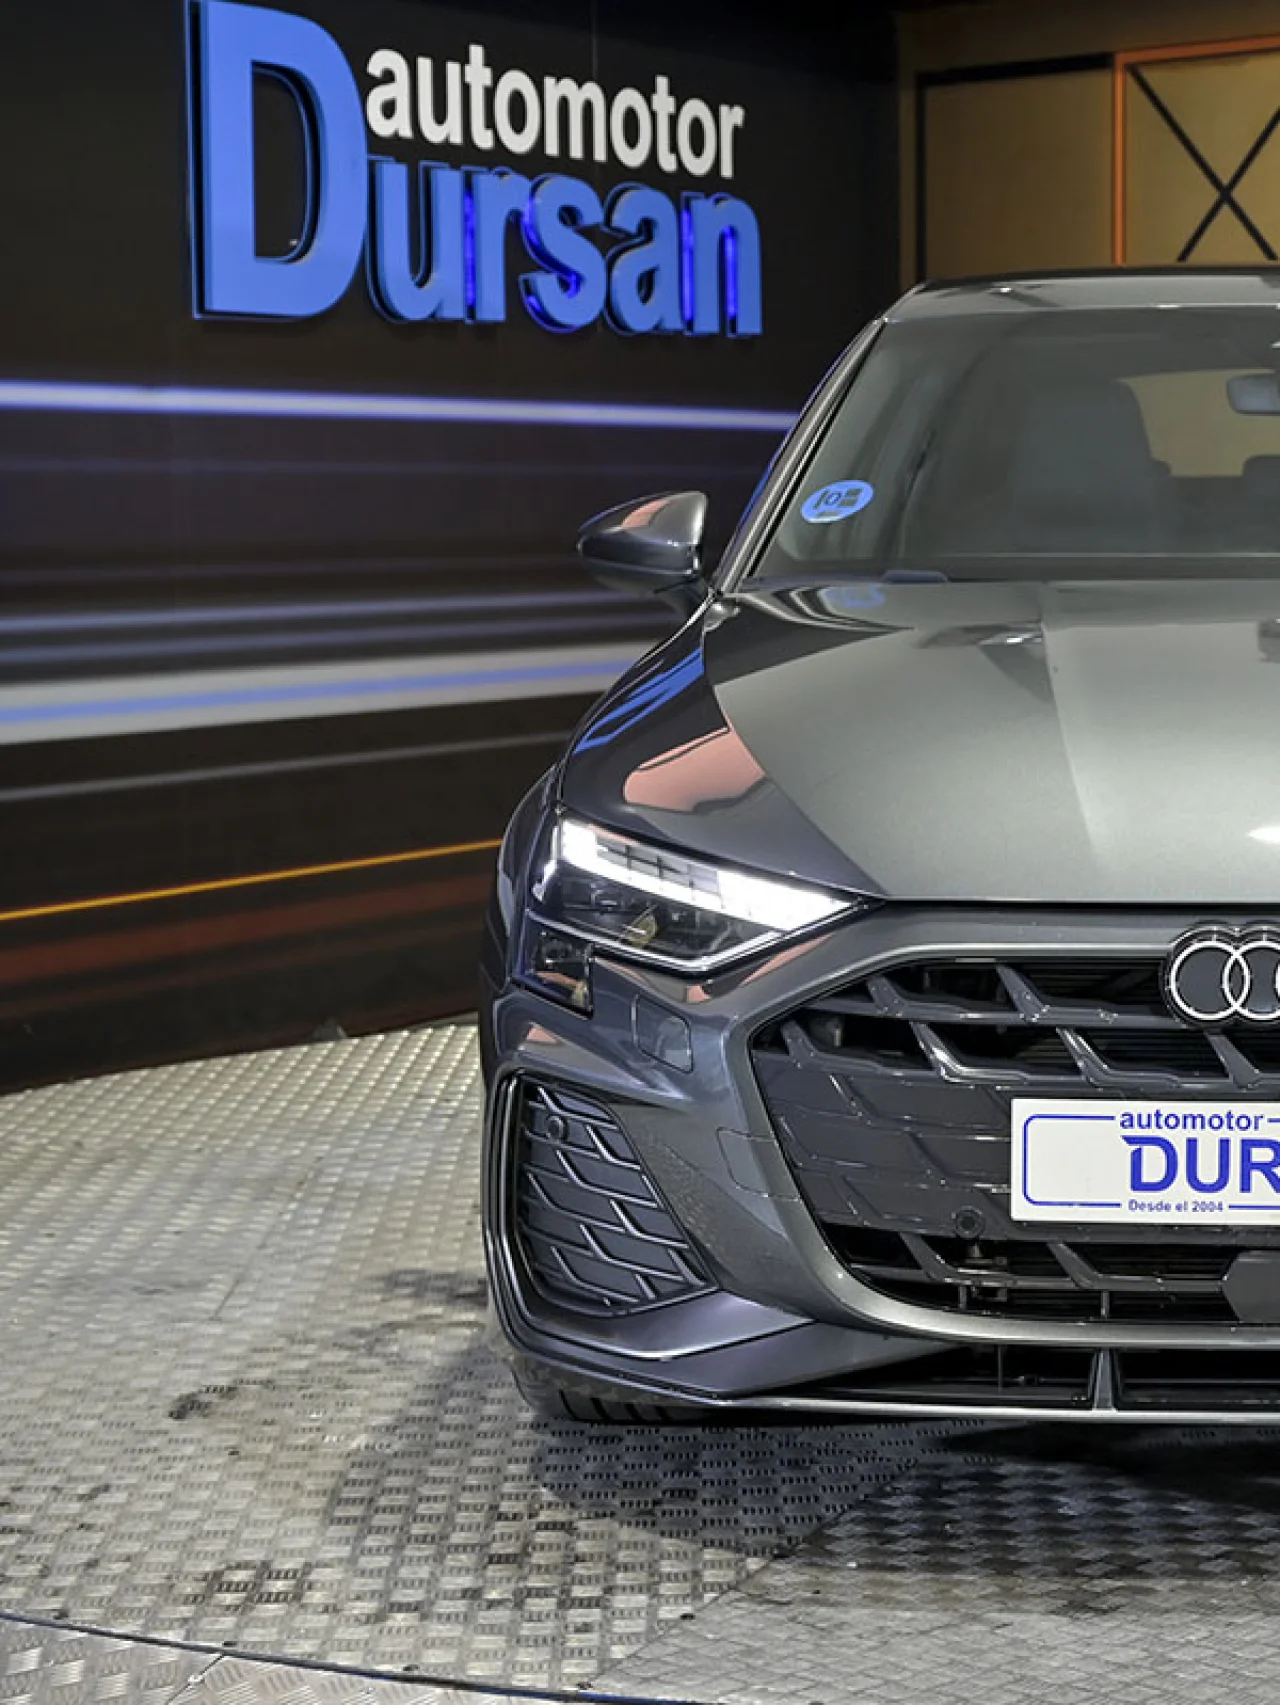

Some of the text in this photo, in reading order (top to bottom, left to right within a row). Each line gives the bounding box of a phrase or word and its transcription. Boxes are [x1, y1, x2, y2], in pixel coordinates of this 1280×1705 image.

[366, 44, 745, 179] automotor
[185, 0, 764, 338] Dursan
[1119, 1109, 1265, 1132] automotor
[1128, 1199, 1224, 1213] Desde el 2004
